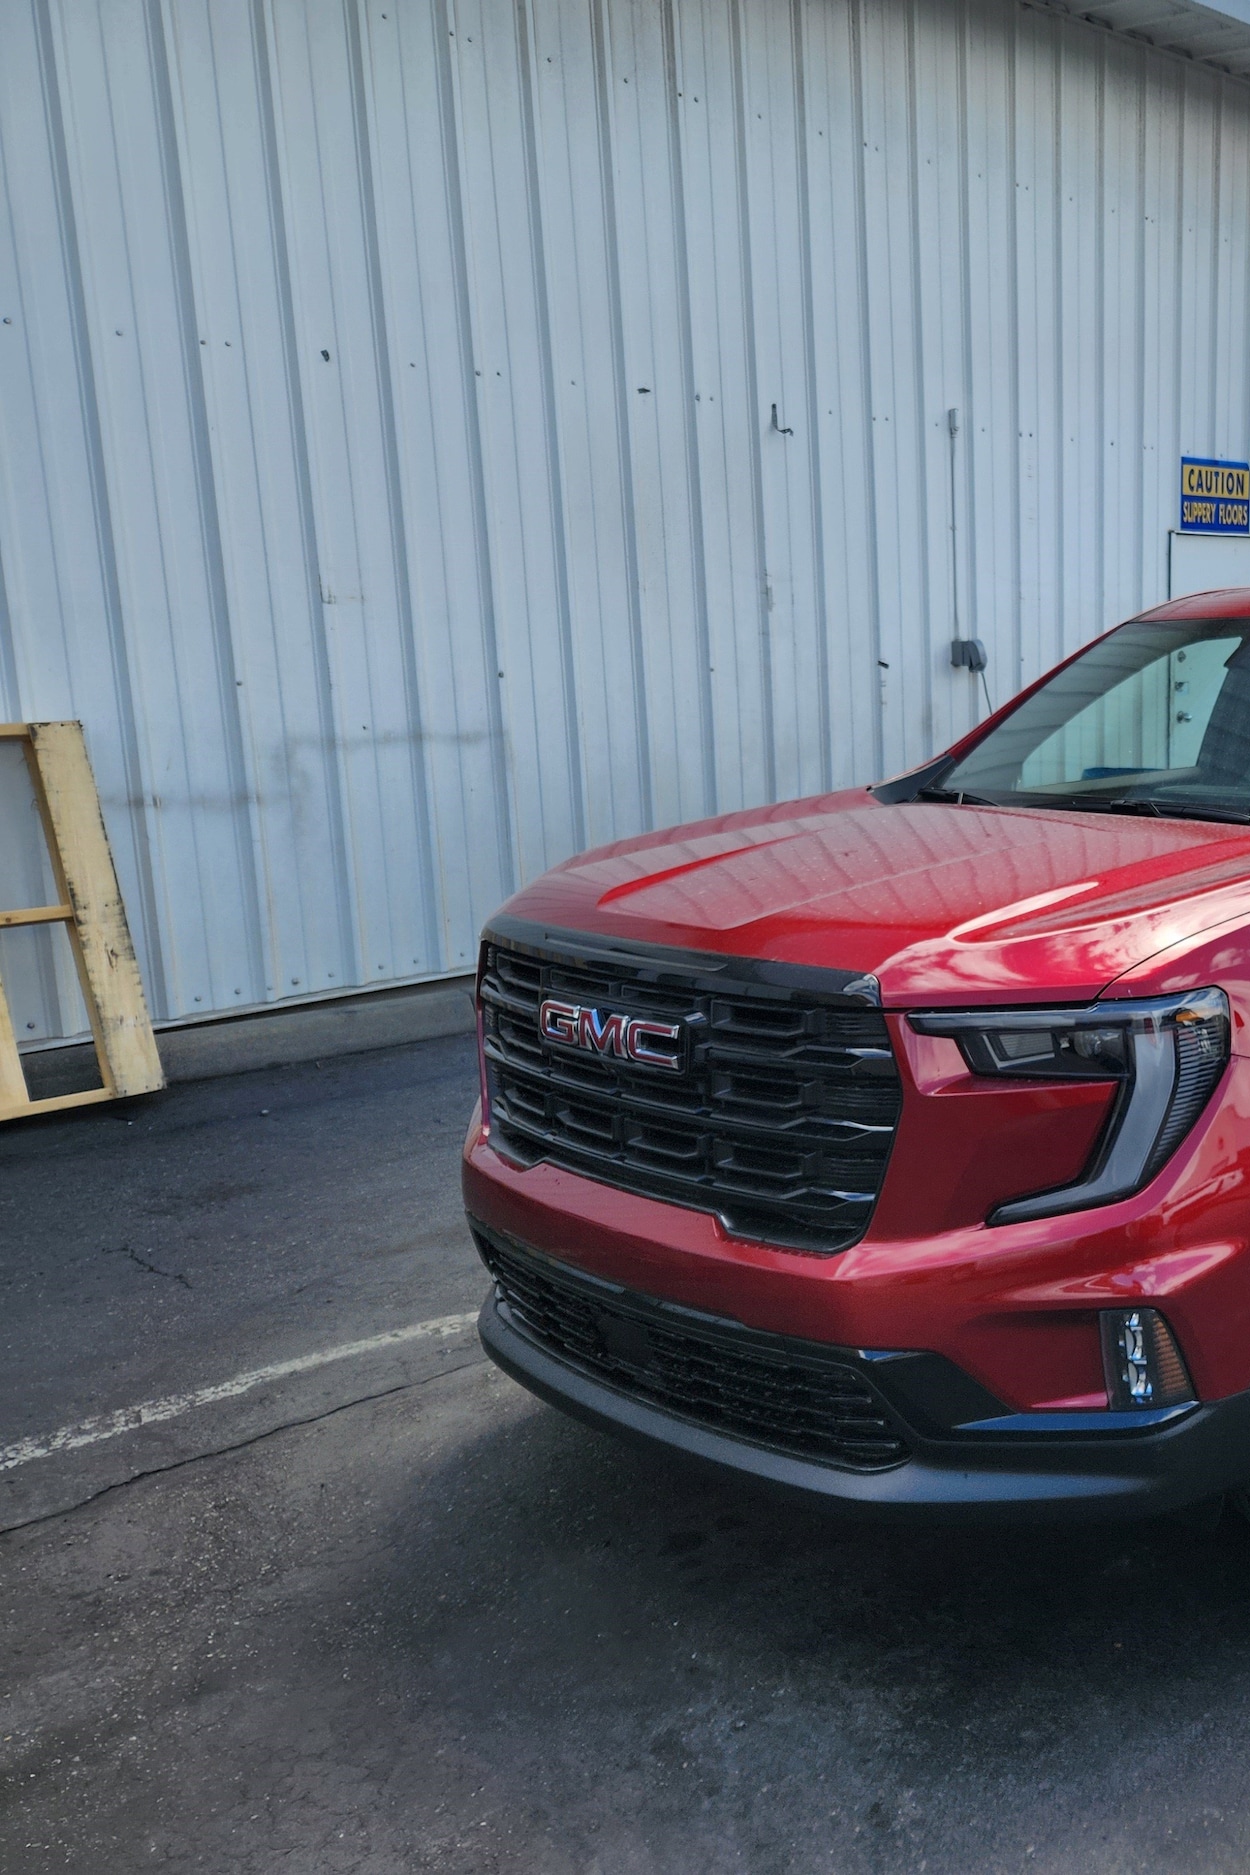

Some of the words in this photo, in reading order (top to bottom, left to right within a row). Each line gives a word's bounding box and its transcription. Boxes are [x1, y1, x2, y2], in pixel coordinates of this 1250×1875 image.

[1188, 468, 1245, 496] CAUTION
[1183, 501, 1216, 524] SLIPPERY
[1219, 503, 1248, 526] FLOORS
[540, 1000, 680, 1070] GMC
